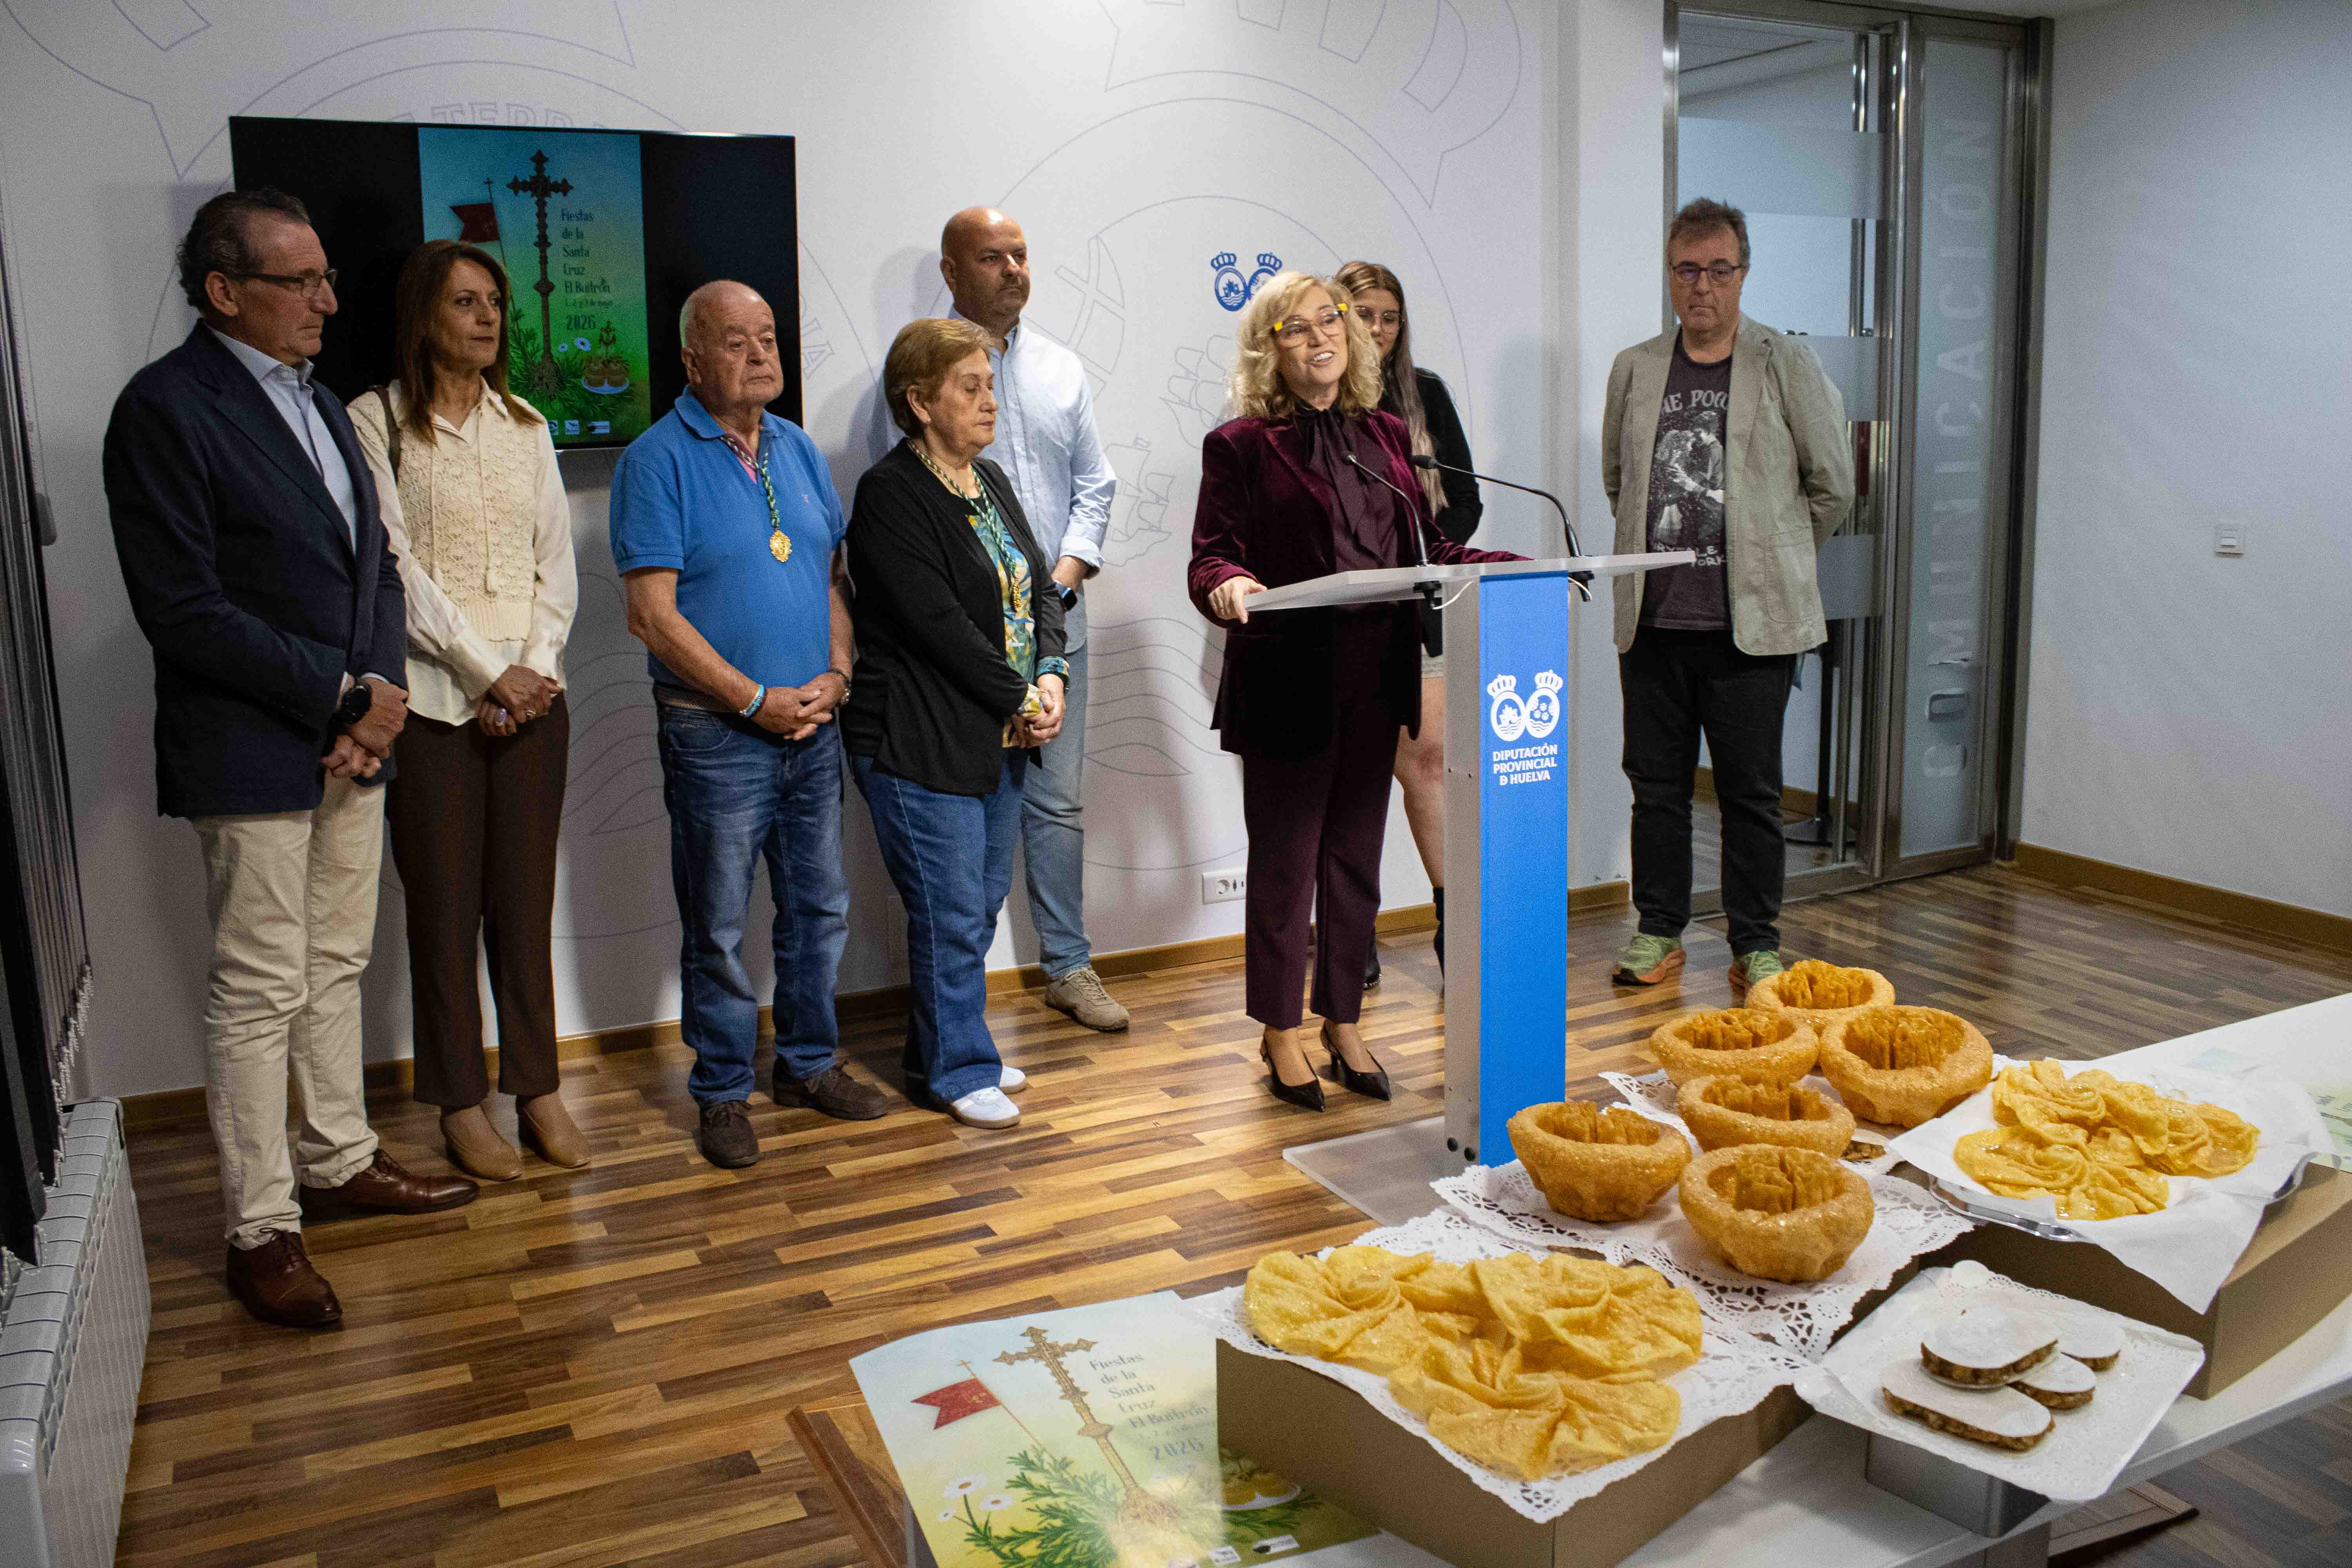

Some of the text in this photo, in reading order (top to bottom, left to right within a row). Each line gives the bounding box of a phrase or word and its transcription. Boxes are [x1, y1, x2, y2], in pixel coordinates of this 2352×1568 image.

[561, 209, 593, 221] Fiestas
[562, 227, 584, 239] de la
[563, 245, 590, 258] Santa
[563, 263, 585, 275] Cruz
[566, 314, 596, 330] 2026
[1493, 743, 1558, 761] DIPUTACIÓN
[1493, 757, 1558, 774] PROVINCIAL
[1510, 770, 1551, 784] HUELVA
[1089, 1354, 1144, 1370] Fiestas
[1101, 1370, 1137, 1384] de la
[1109, 1383, 1156, 1398] Santa
[1149, 1437, 1204, 1461] 2026
